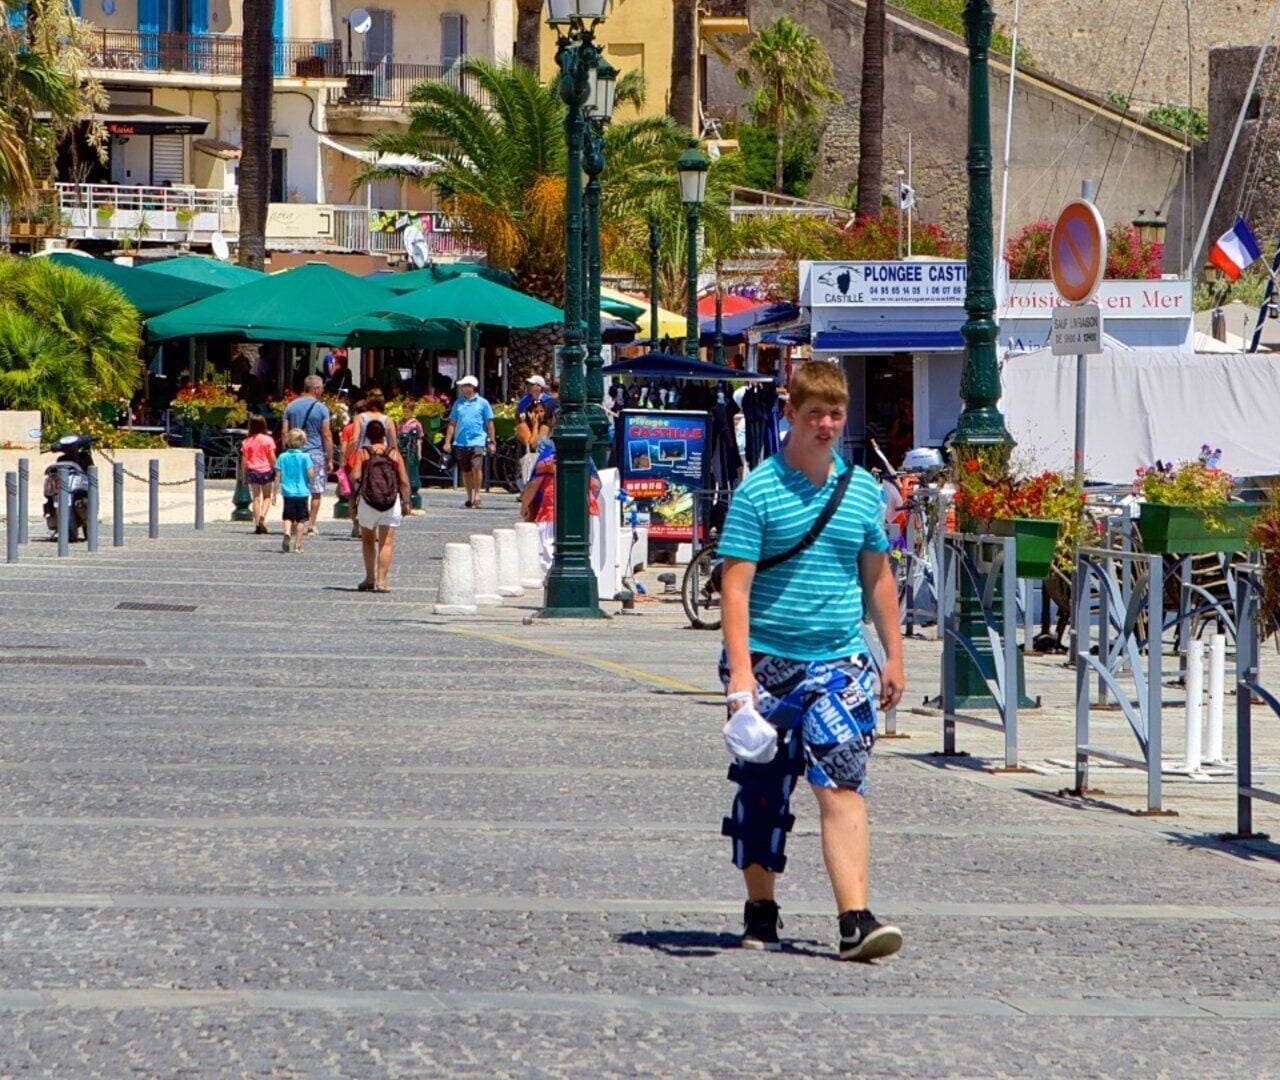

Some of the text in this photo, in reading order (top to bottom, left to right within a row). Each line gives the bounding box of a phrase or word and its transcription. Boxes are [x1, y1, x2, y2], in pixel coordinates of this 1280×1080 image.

[865, 266, 922, 281] PLONGEE
[825, 293, 864, 303] CASTILLE
[1107, 295, 1131, 308] en
[1142, 290, 1183, 308] Mer
[628, 425, 702, 439] CASTILLE
